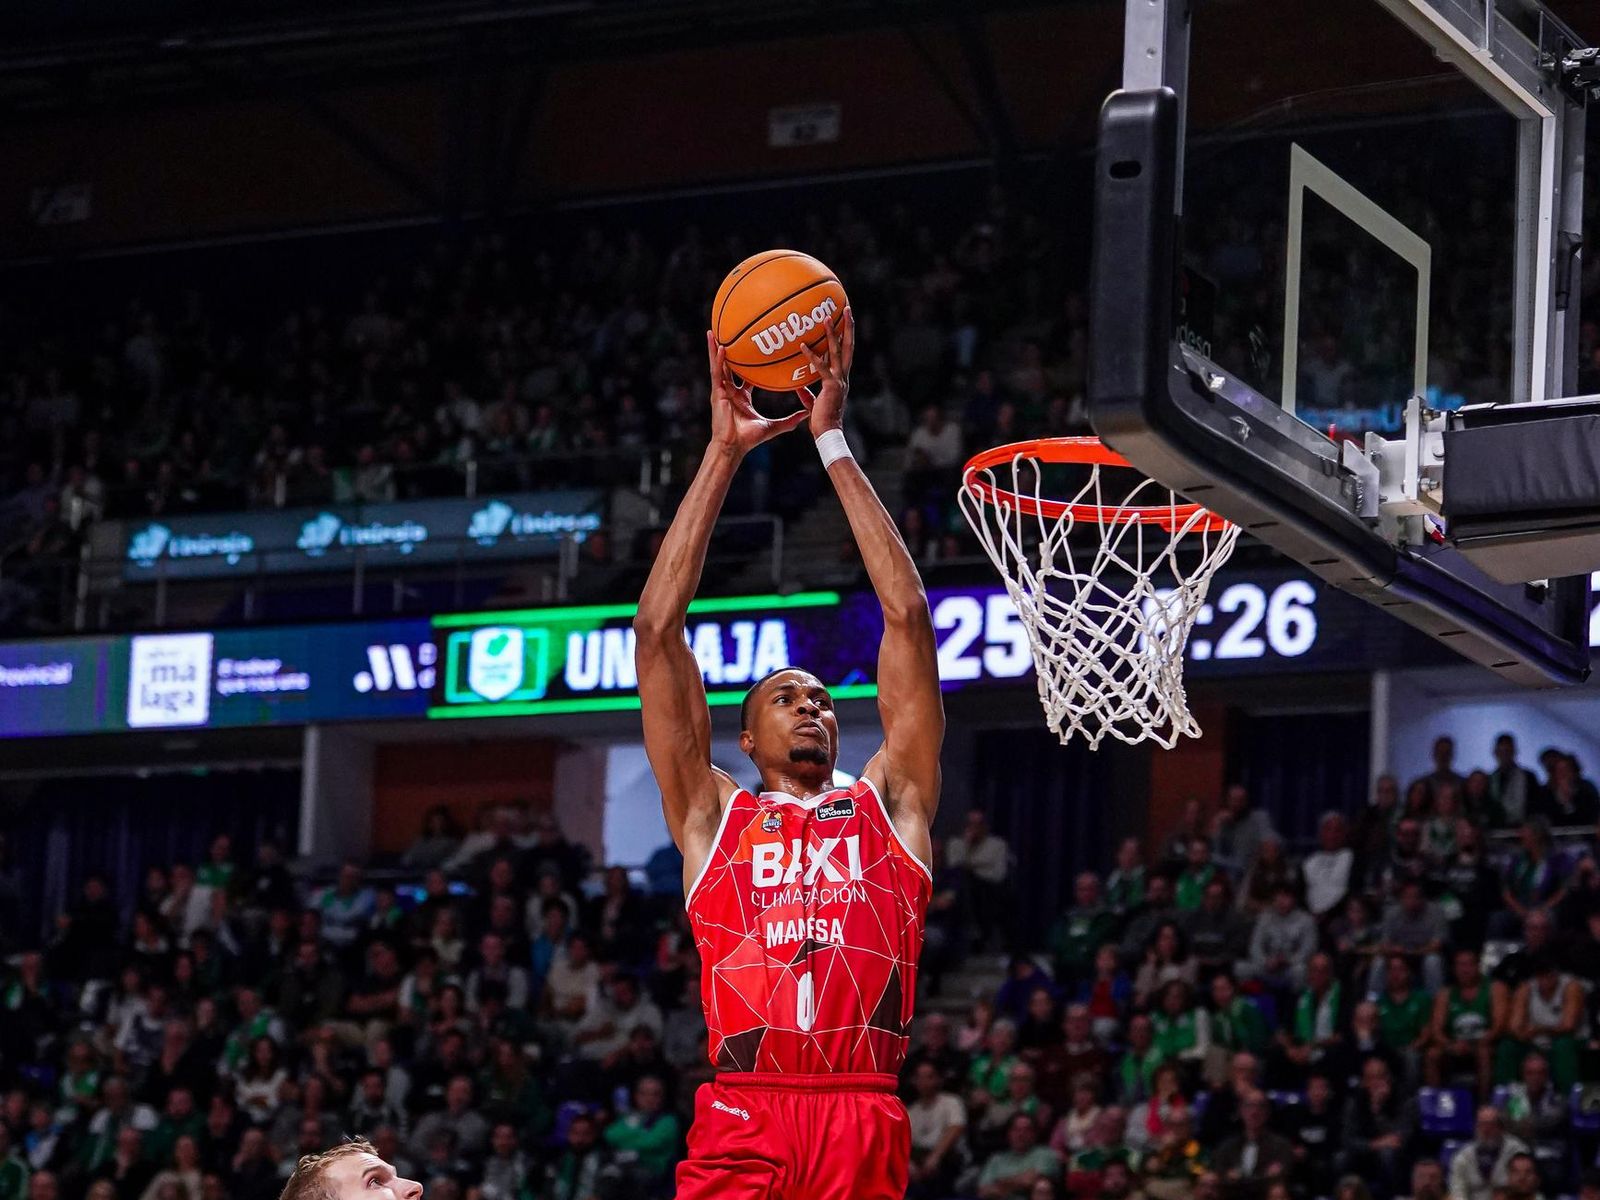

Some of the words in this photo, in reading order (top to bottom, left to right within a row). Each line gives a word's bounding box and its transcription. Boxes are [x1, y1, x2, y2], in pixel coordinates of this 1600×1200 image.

[751, 297, 838, 356] Wilson
[564, 618, 793, 692] UNAJA
[752, 835, 863, 888] BAXI
